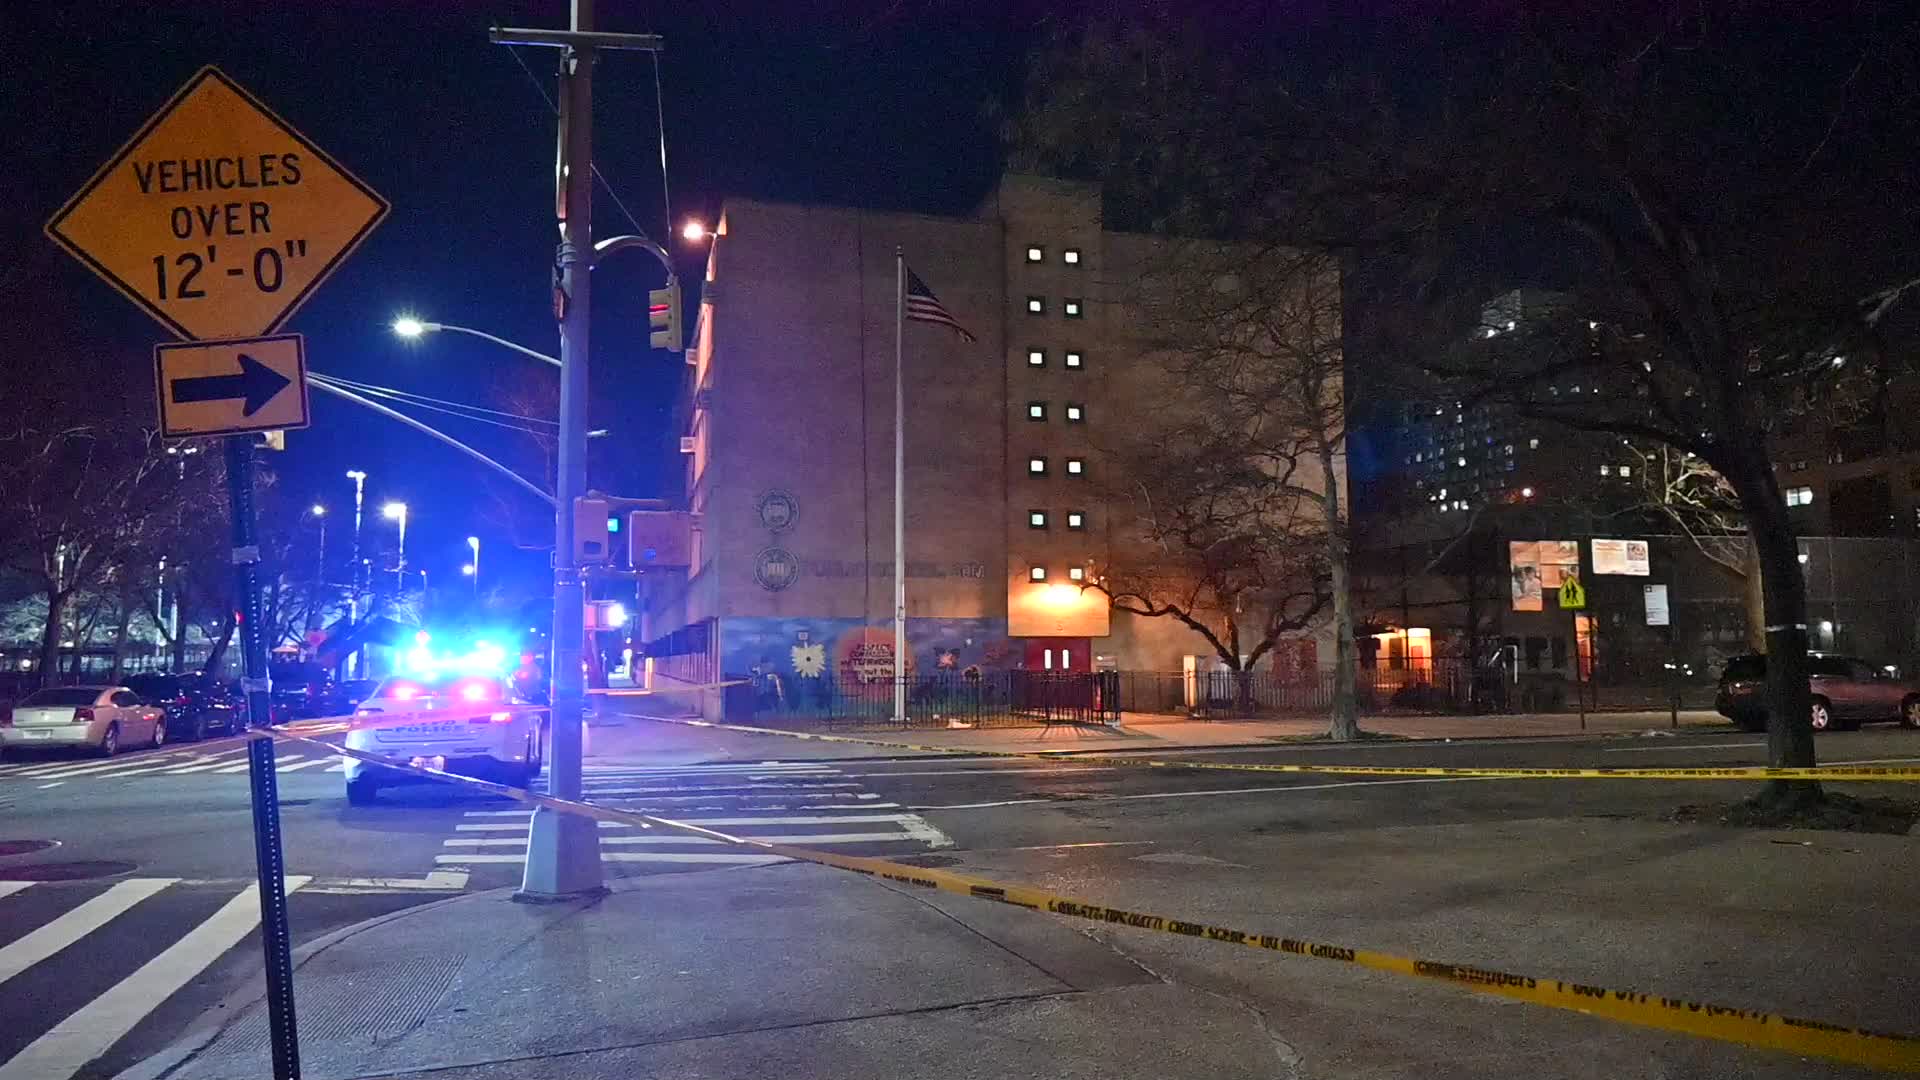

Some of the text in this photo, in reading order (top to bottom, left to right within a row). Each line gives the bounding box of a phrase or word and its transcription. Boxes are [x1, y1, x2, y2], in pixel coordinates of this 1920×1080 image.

[132, 153, 302, 195] VEHICLES
[171, 201, 272, 240] OVER
[152, 239, 308, 301] 12'-0"
